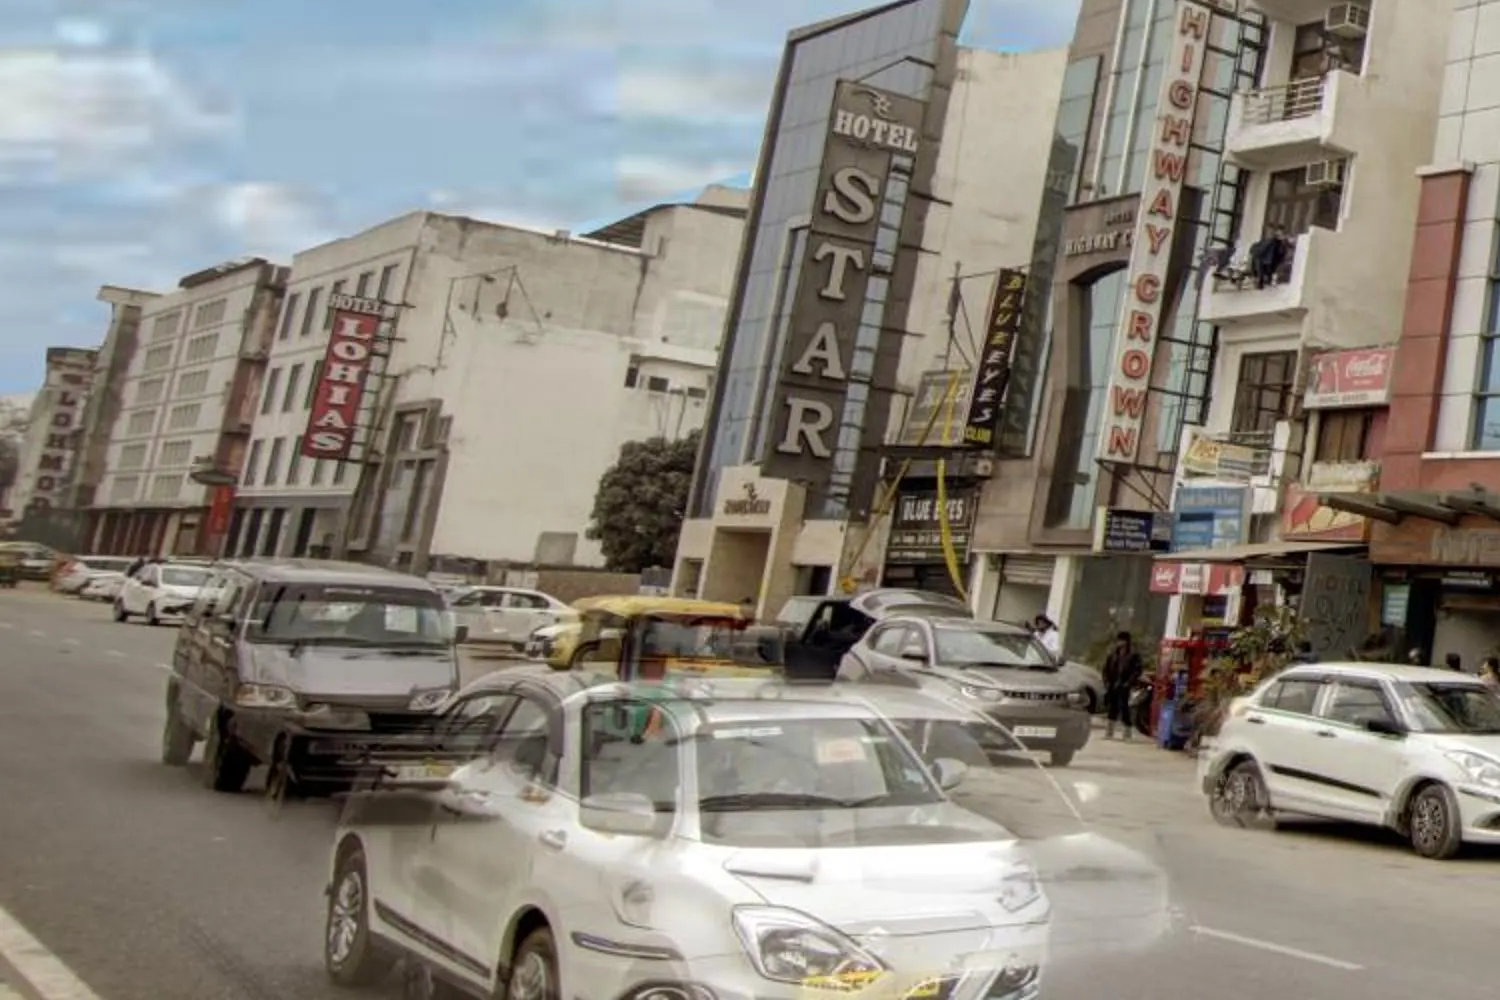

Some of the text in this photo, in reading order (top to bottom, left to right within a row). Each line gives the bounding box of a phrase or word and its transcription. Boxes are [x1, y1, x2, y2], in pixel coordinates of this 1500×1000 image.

[832, 109, 918, 153] HOTEL
[1145, 7, 1206, 255] HIGHWAY
[307, 317, 377, 452] LOHIAS
[330, 295, 385, 315] HOTEL
[778, 166, 880, 458] STAR
[1107, 273, 1160, 457] CROWN
